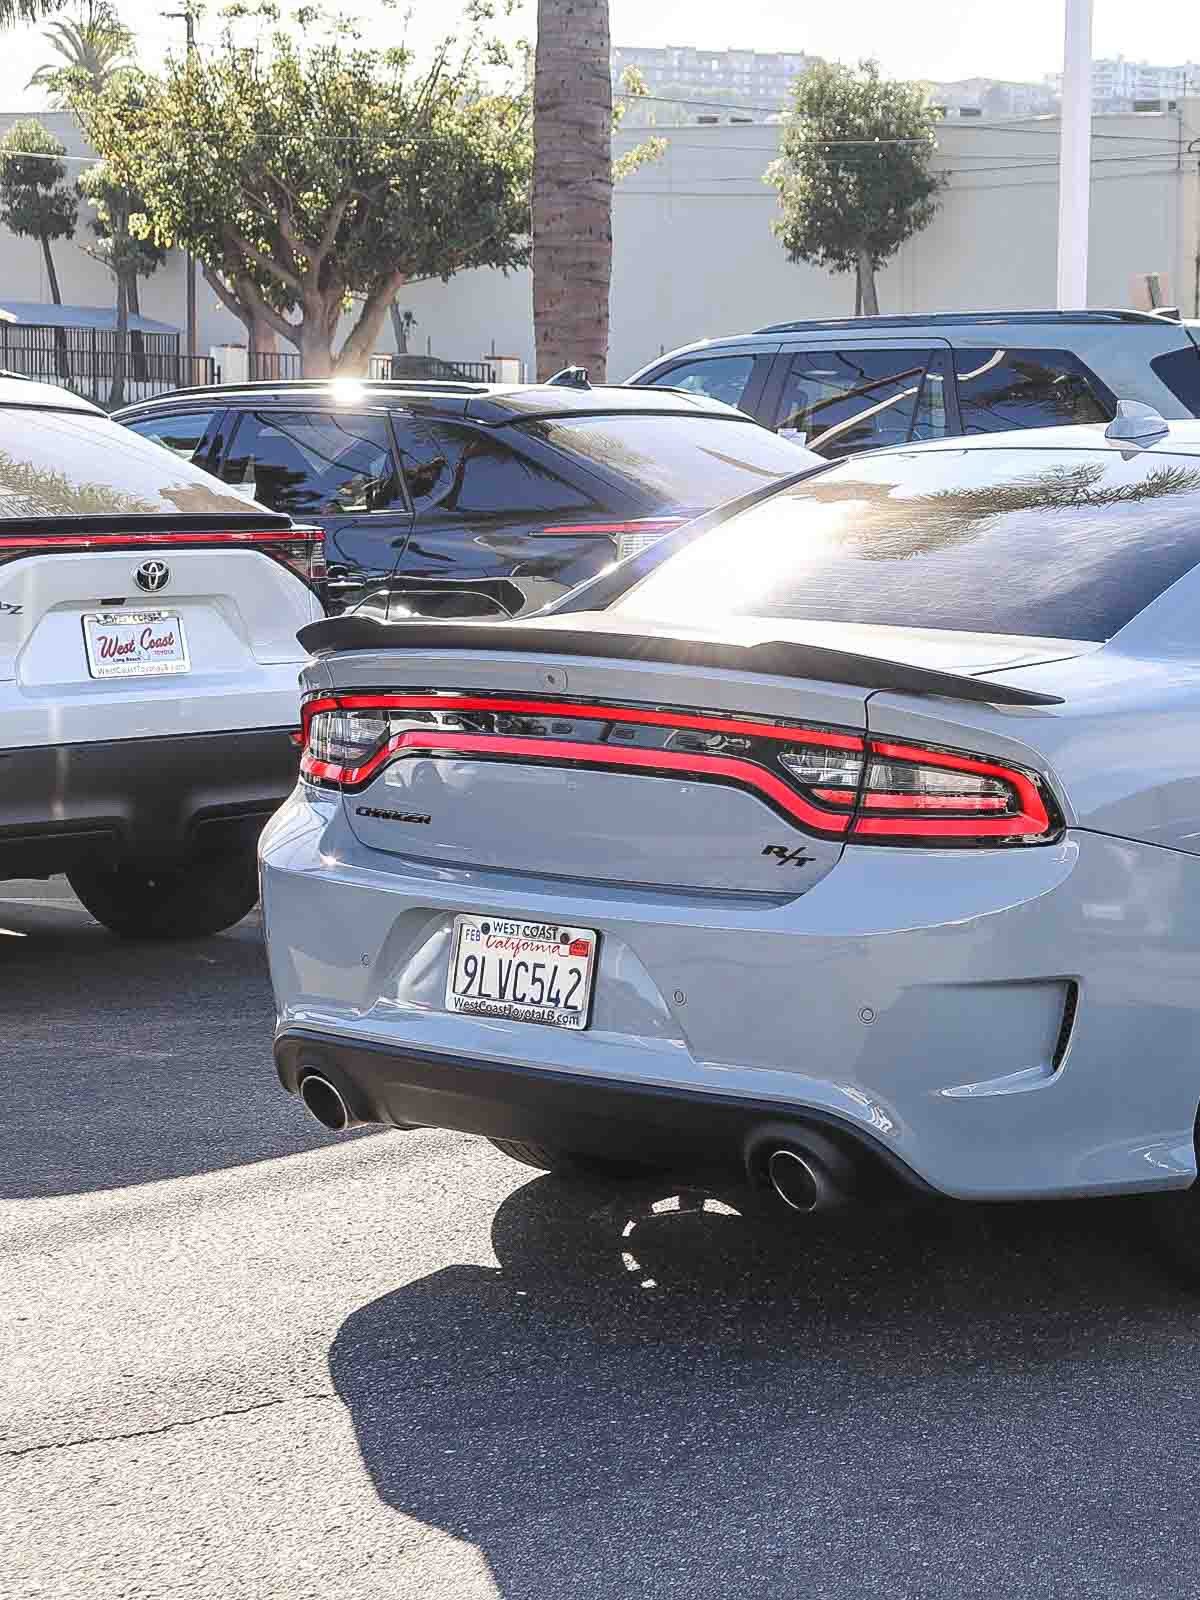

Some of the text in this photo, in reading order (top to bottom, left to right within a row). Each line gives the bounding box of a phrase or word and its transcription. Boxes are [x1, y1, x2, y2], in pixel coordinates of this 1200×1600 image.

[96, 627, 175, 658] West Coast
[761, 845, 816, 867] R/T
[465, 928, 481, 942] FEB
[493, 921, 558, 941] WEST COAST
[485, 935, 561, 958] California
[462, 955, 582, 1010] 9LVC542
[454, 997, 580, 1025] WestCoastToyotaLB.com
